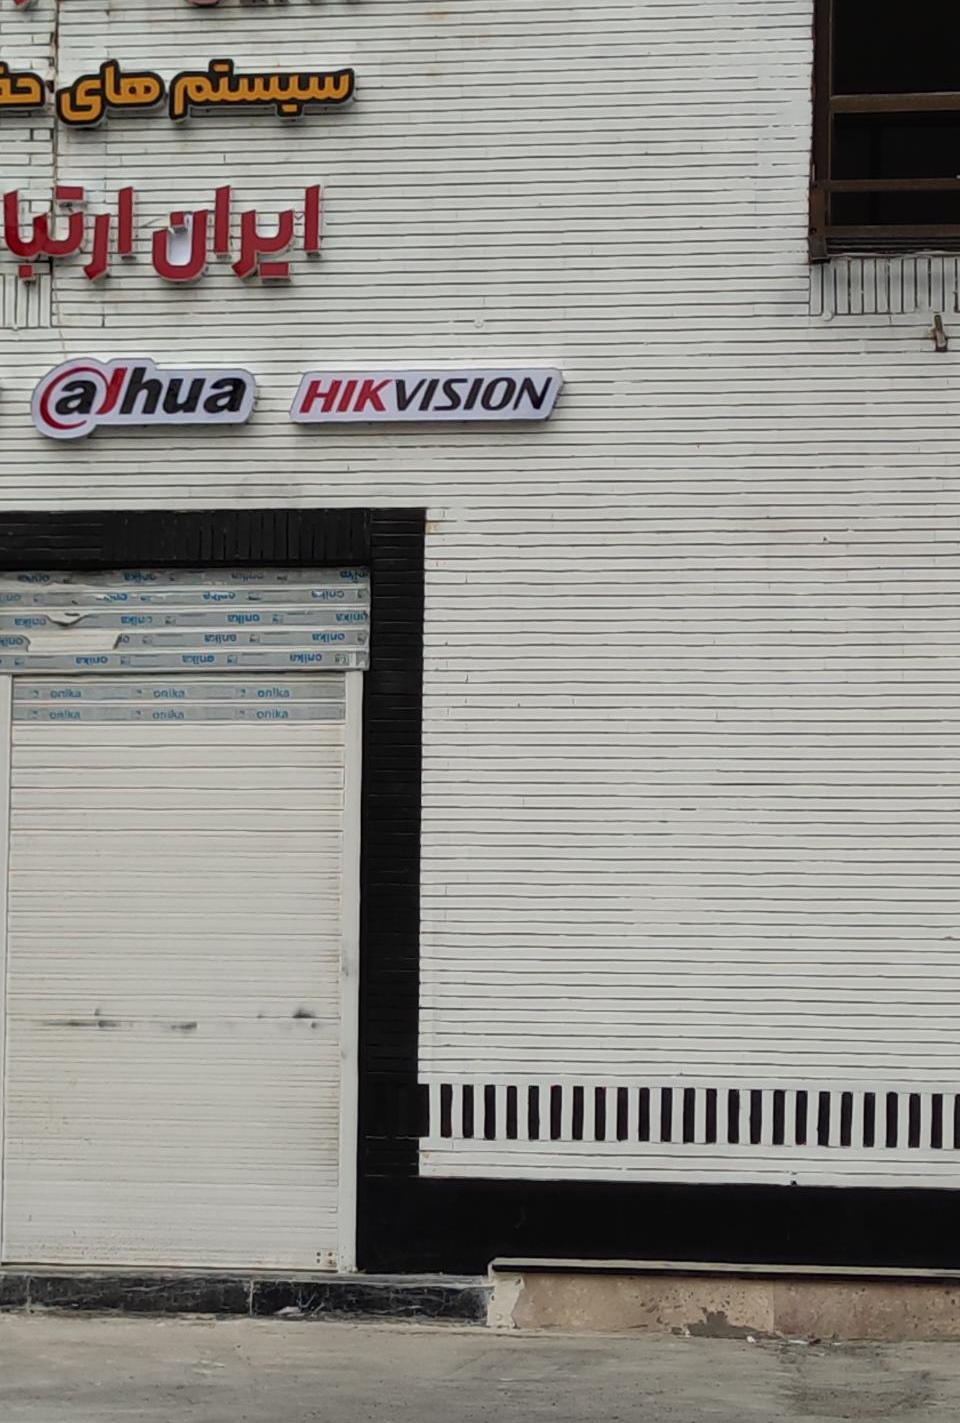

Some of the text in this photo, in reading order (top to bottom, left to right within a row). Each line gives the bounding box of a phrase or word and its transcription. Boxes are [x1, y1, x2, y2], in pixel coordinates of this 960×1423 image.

[56, 59, 164, 128] های
[168, 59, 355, 121] سیستم
[151, 184, 321, 281] ایران
[298, 376, 553, 414] HIKVISION
[76, 653, 323, 665] onika onika onika
[50, 687, 290, 699] onika onika onika
[49, 709, 289, 720] onika onika onika
